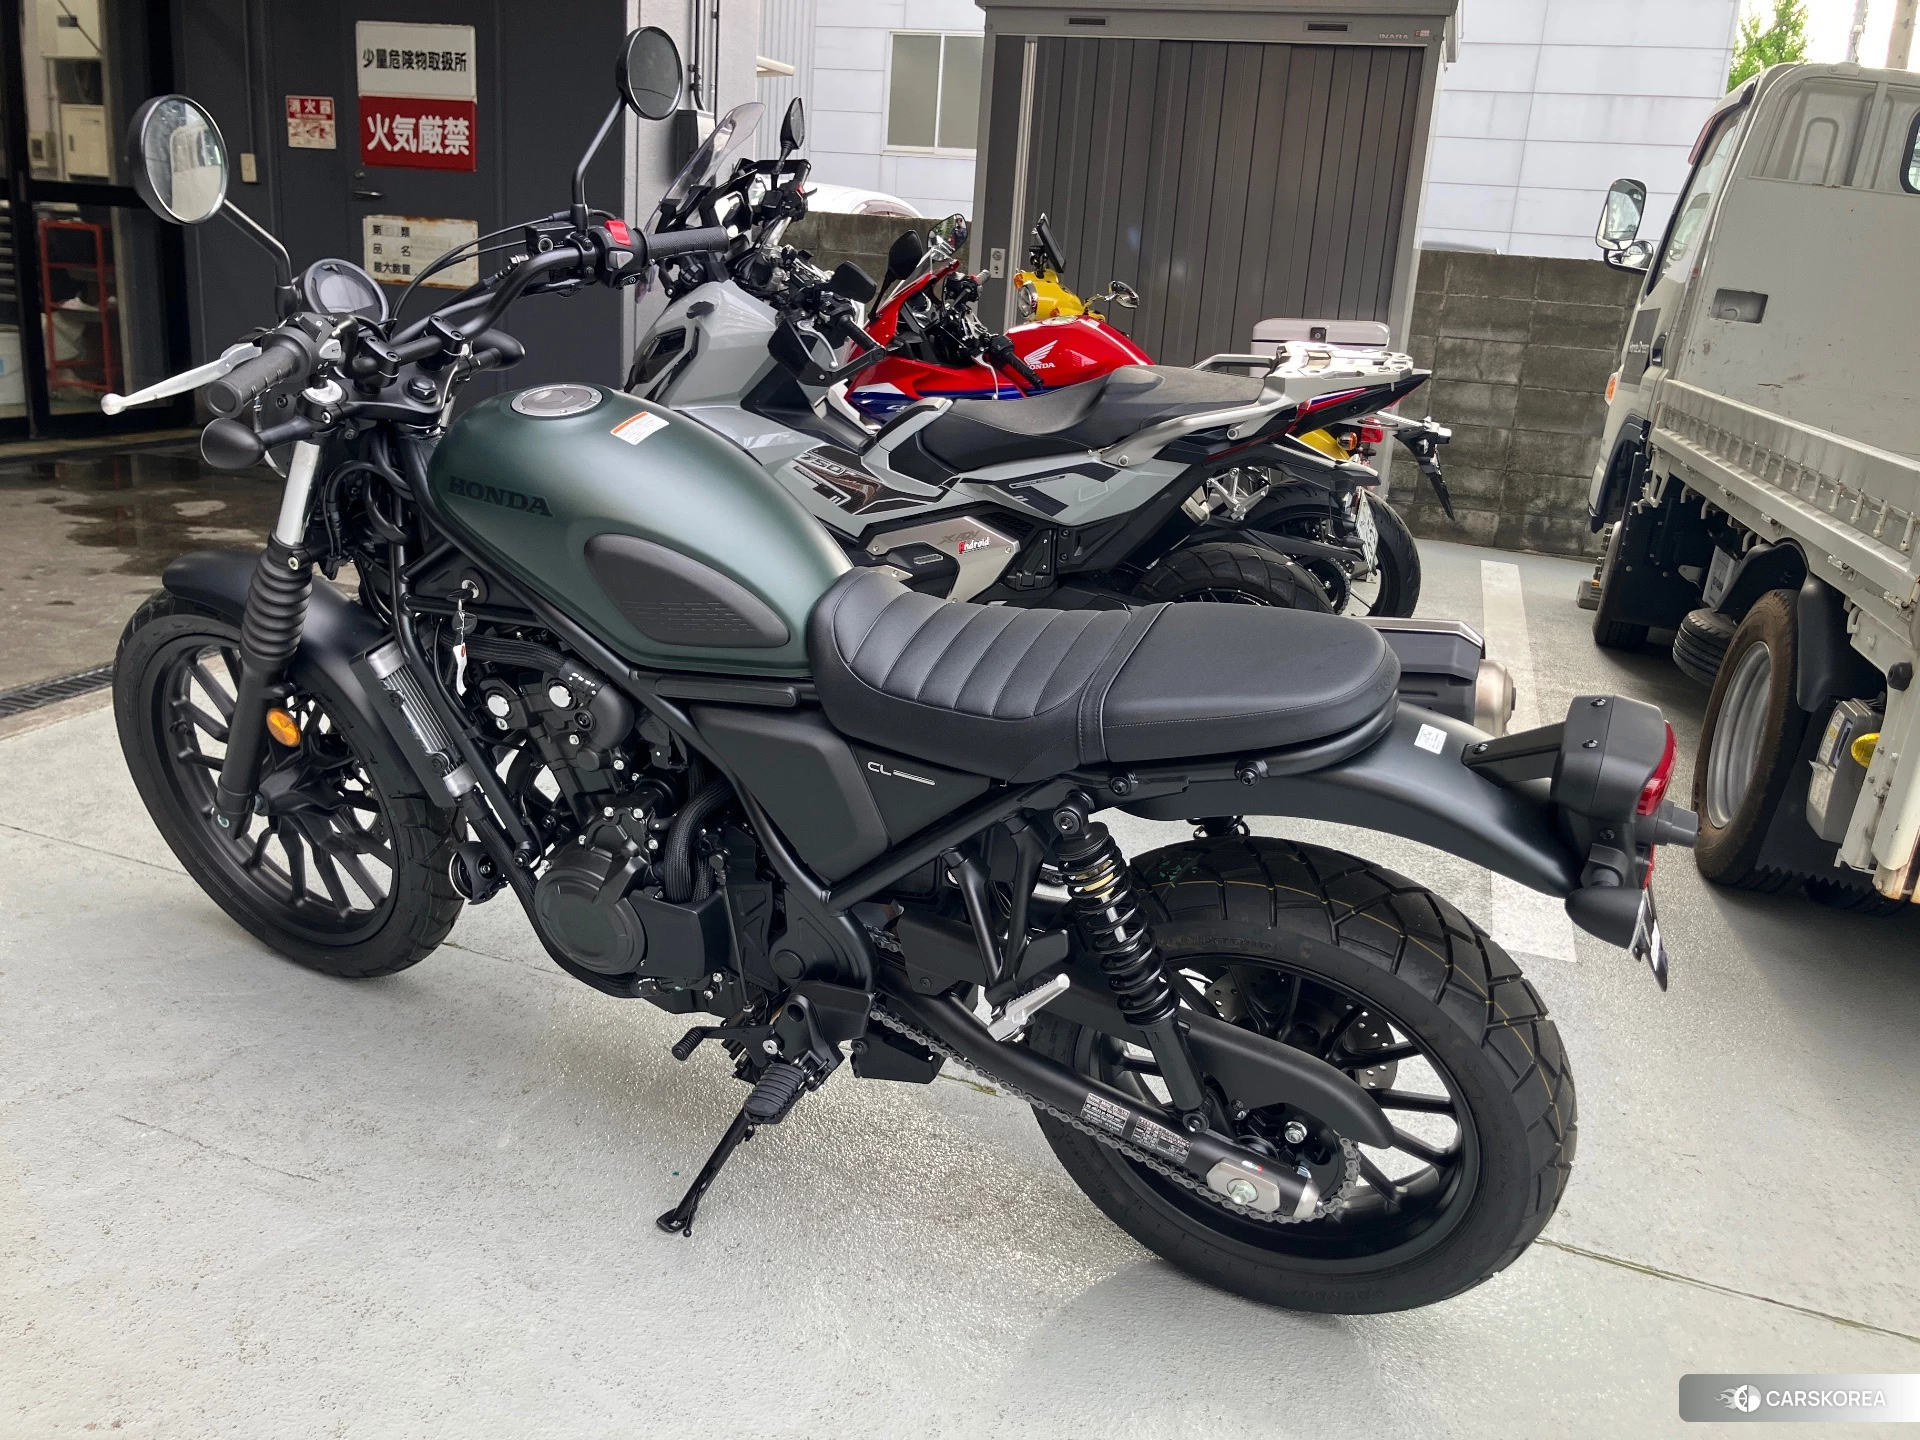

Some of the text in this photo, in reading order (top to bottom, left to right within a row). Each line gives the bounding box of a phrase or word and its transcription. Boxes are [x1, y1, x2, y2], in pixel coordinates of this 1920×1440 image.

[362, 47, 467, 72] 少量危険物取扱所
[366, 112, 470, 156] 火気厳禁
[1029, 361, 1056, 371] ONDA
[448, 475, 554, 518] HONDA
[958, 536, 991, 554] Android
[867, 761, 892, 777] CL
